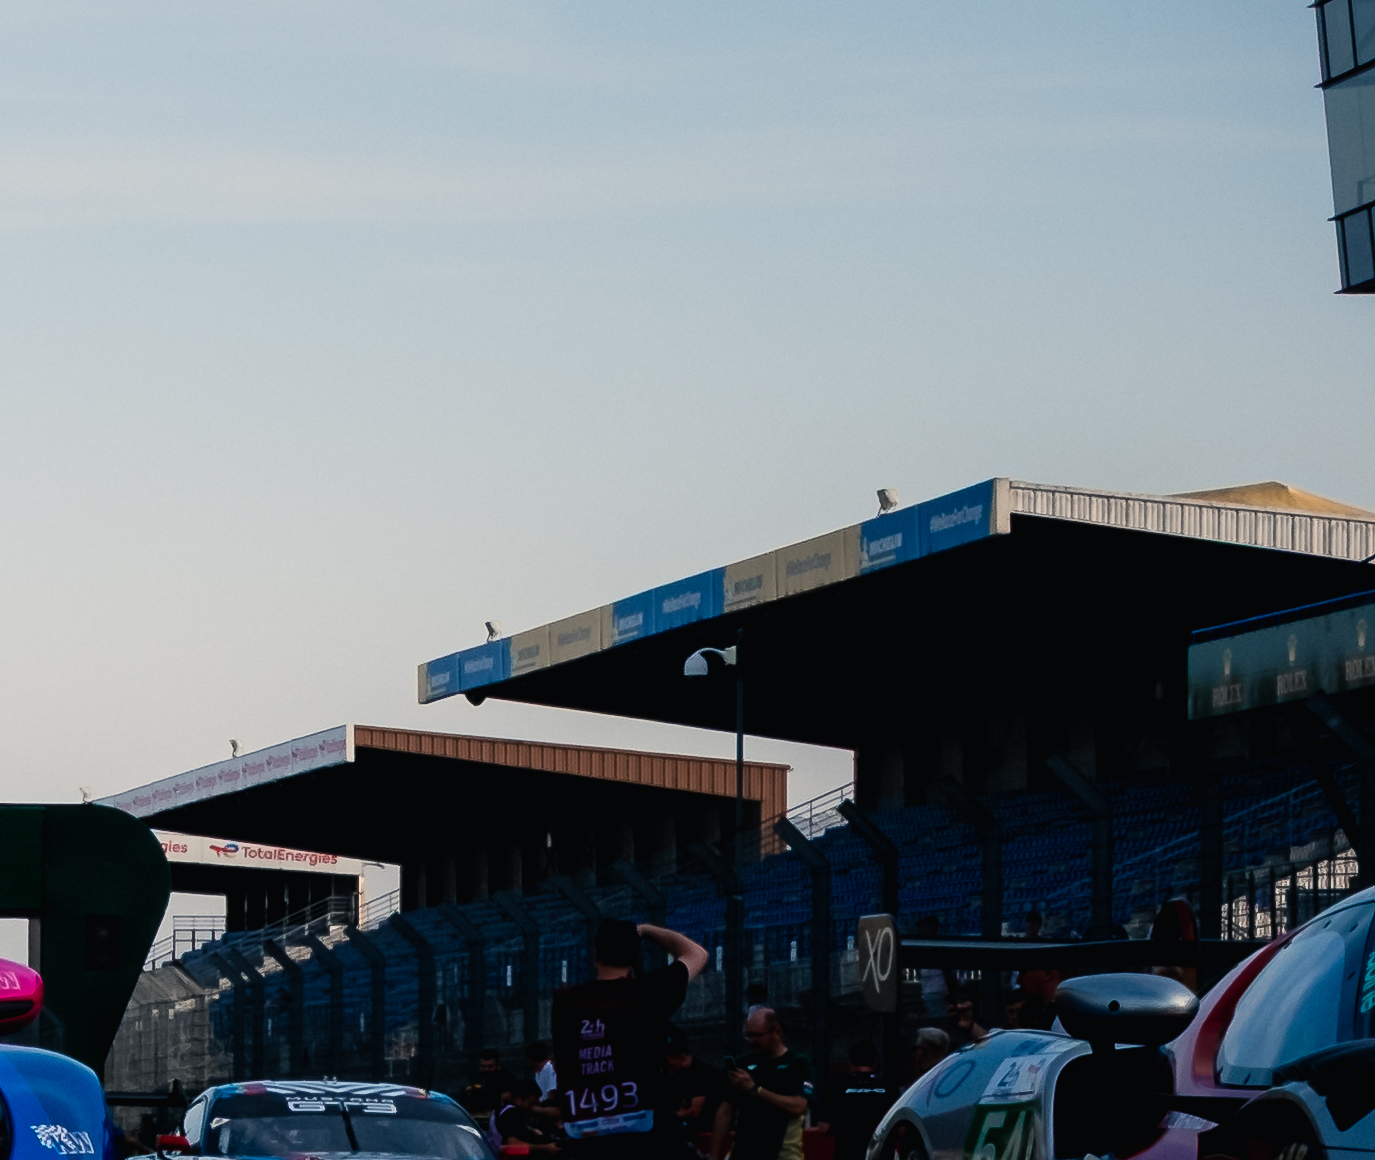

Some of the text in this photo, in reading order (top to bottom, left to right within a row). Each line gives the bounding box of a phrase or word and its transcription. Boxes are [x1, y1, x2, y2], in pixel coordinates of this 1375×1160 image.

[241, 846, 338, 867] TotalEnergies
[862, 927, 894, 993] XO
[579, 1044, 613, 1060] MEDIA
[581, 1060, 615, 1075] TRACK
[565, 1081, 639, 1116] 1493
